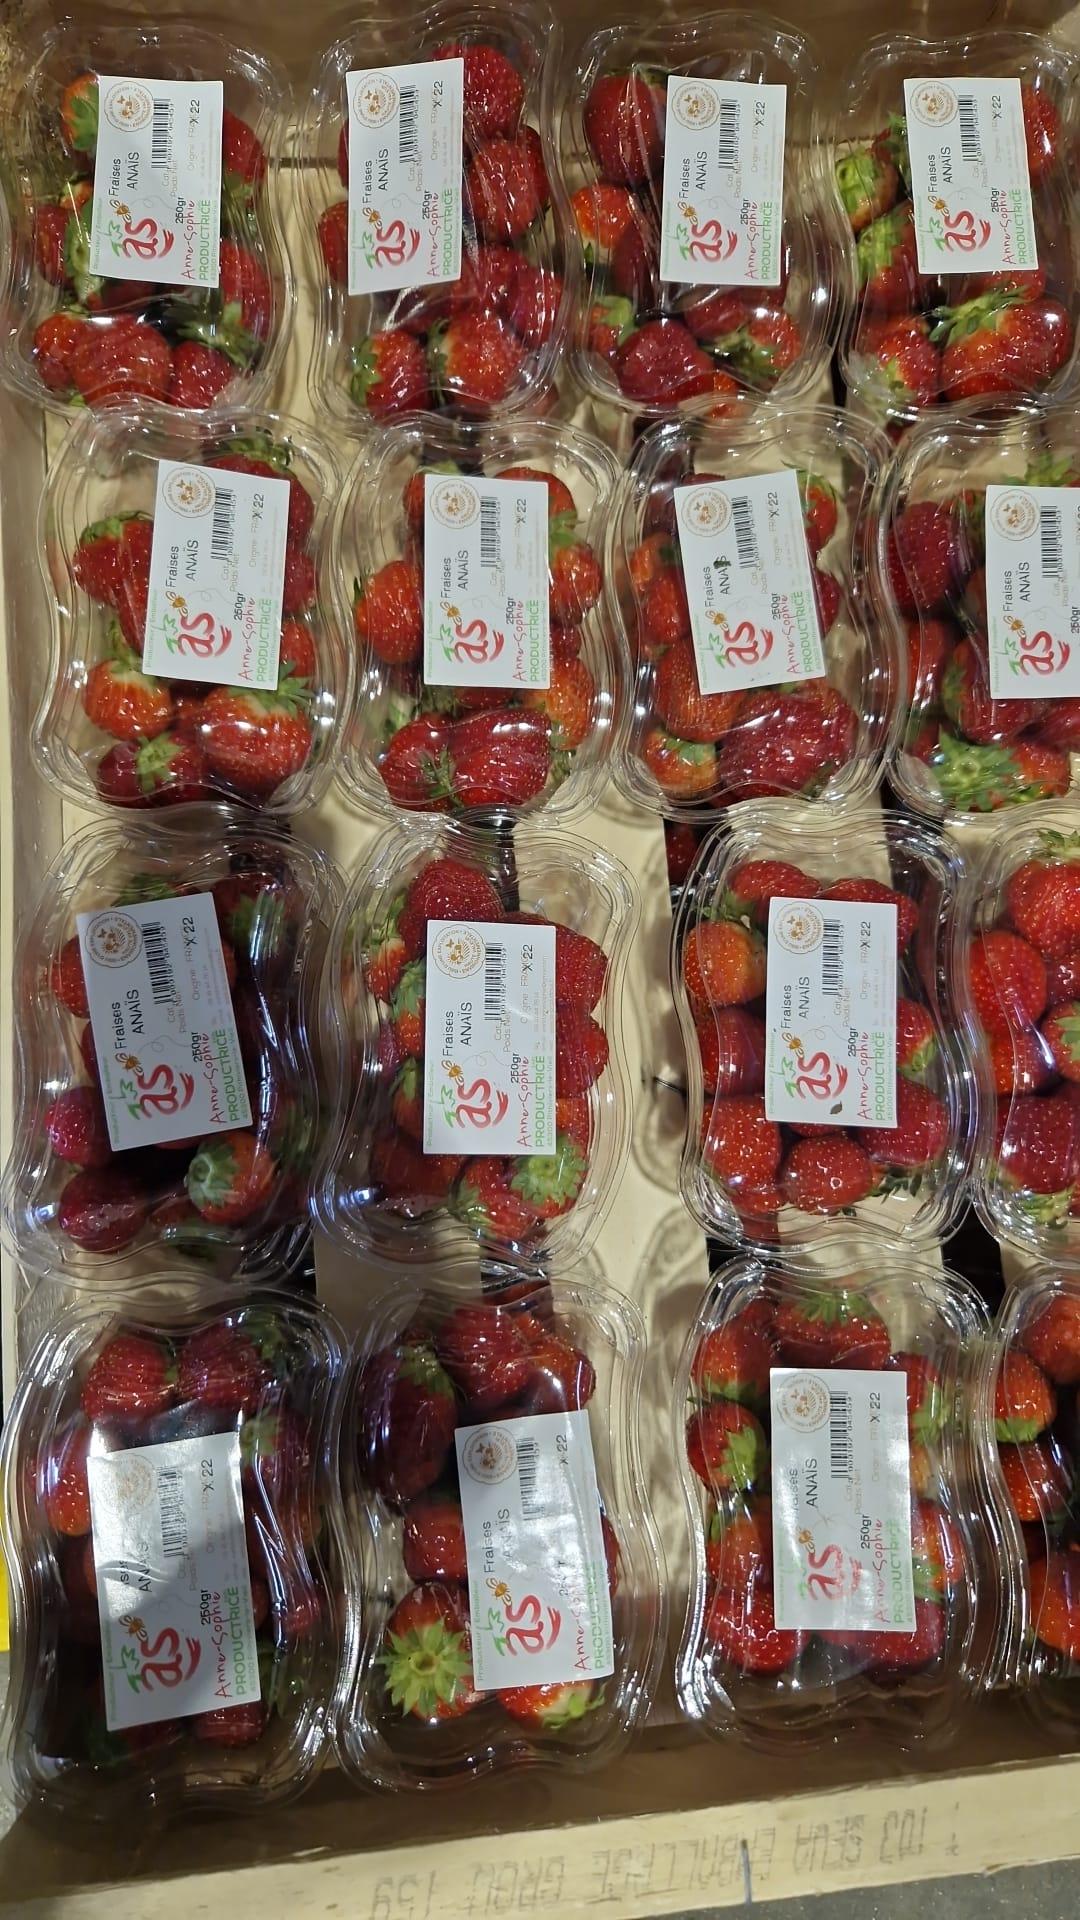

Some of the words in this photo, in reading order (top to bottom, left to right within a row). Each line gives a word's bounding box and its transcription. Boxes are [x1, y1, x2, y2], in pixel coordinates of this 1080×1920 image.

[189, 99, 200, 113] 22
[433, 79, 442, 96] 22
[755, 101, 765, 115] 22
[991, 95, 1001, 108] 22
[109, 157, 121, 197] Fraises
[125, 151, 139, 191] ANAÏS
[362, 160, 372, 204] Fraises
[376, 148, 388, 191] ANAÏS
[678, 157, 690, 198] Fraises
[693, 150, 707, 190] ANAÏS
[924, 154, 938, 192] Fraises
[938, 146, 954, 183] ANAÏS
[174, 196, 186, 224] 250gr
[421, 189, 431, 218] 250gr
[739, 198, 750, 225] 250gr
[989, 187, 1001, 213] 250gr
[121, 215, 158, 260] as
[181, 201, 201, 280] Anne-Sophie
[200, 201, 211, 281] PRODUCTRICE
[374, 218, 406, 268] as
[427, 192, 444, 275] Anne-Sophie
[443, 189, 452, 274] PRODUCTRICE
[688, 218, 723, 262] as
[744, 201, 763, 279] Anne-Sophie
[761, 201, 772, 279] PRODUCTRICE
[941, 209, 978, 251] as
[996, 190, 1015, 265] Anne-Sophie
[1011, 189, 1027, 264] PRODUCTRICE
[252, 493, 264, 508] 22
[516, 498, 526, 513] 22
[766, 491, 778, 506] 22
[164, 544, 179, 588] Fraises
[182, 538, 199, 581] ANAÏS
[440, 557, 451, 598] Fraises
[456, 549, 468, 590] ANAÏS
[1016, 561, 1031, 602] ANAÏS
[233, 591, 245, 621] 250gr
[699, 566, 715, 607] Fraises
[769, 592, 782, 620] 250gr
[1000, 570, 1013, 612] Fraises
[505, 597, 515, 625] 250gr
[778, 593, 801, 673] Anne-Sophie
[793, 590, 814, 672] PRODUCTRICE
[175, 608, 216, 659] as
[237, 596, 260, 680] Anne-Sophie
[256, 597, 271, 681] PRODUCTRICE
[453, 617, 488, 663] as
[512, 599, 530, 681] Anne-Sophie
[529, 600, 539, 681] PRODUCTRICE
[720, 619, 761, 668] as
[1017, 630, 1055, 675] as
[181, 917, 195, 934] 22
[860, 921, 870, 936] 22
[522, 943, 532, 959] 22
[123, 988, 145, 1036] ANAÏS
[780, 984, 792, 1028] Fraises
[796, 975, 810, 1019] ANAÏS
[107, 1001, 127, 1050] Fraises
[441, 1010, 453, 1056] Fraises
[458, 1001, 472, 1046] ANAÏS
[847, 1027, 858, 1057] 250gr
[188, 1030, 205, 1063] 250gr
[510, 1052, 520, 1083] 250gr
[133, 1062, 180, 1119] as
[198, 1032, 227, 1123] Anne-Sophie
[214, 1029, 241, 1121] PRODUCTRICE
[795, 1049, 831, 1100] as
[856, 1031, 875, 1120] Anne-Sophie
[874, 1031, 885, 1120] PRODUCTRICE
[455, 1077, 492, 1128] as
[516, 1055, 536, 1147] Anne-Sophie
[535, 1055, 545, 1146] PRODUCTRICE
[869, 1392, 880, 1409] 22
[555, 1433, 568, 1451] 22
[200, 1458, 213, 1477] 22
[803, 1457, 818, 1507] ANAÏS
[479, 1521, 496, 1573] Fraises
[859, 1514, 872, 1549] 250gr
[198, 1588, 213, 1625] 250gr
[502, 1593, 546, 1655] as
[137, 1625, 184, 1693] as
[208, 1588, 232, 1696] Anne-Sophie
[227, 1584, 247, 1694] PRODUCTRICE
